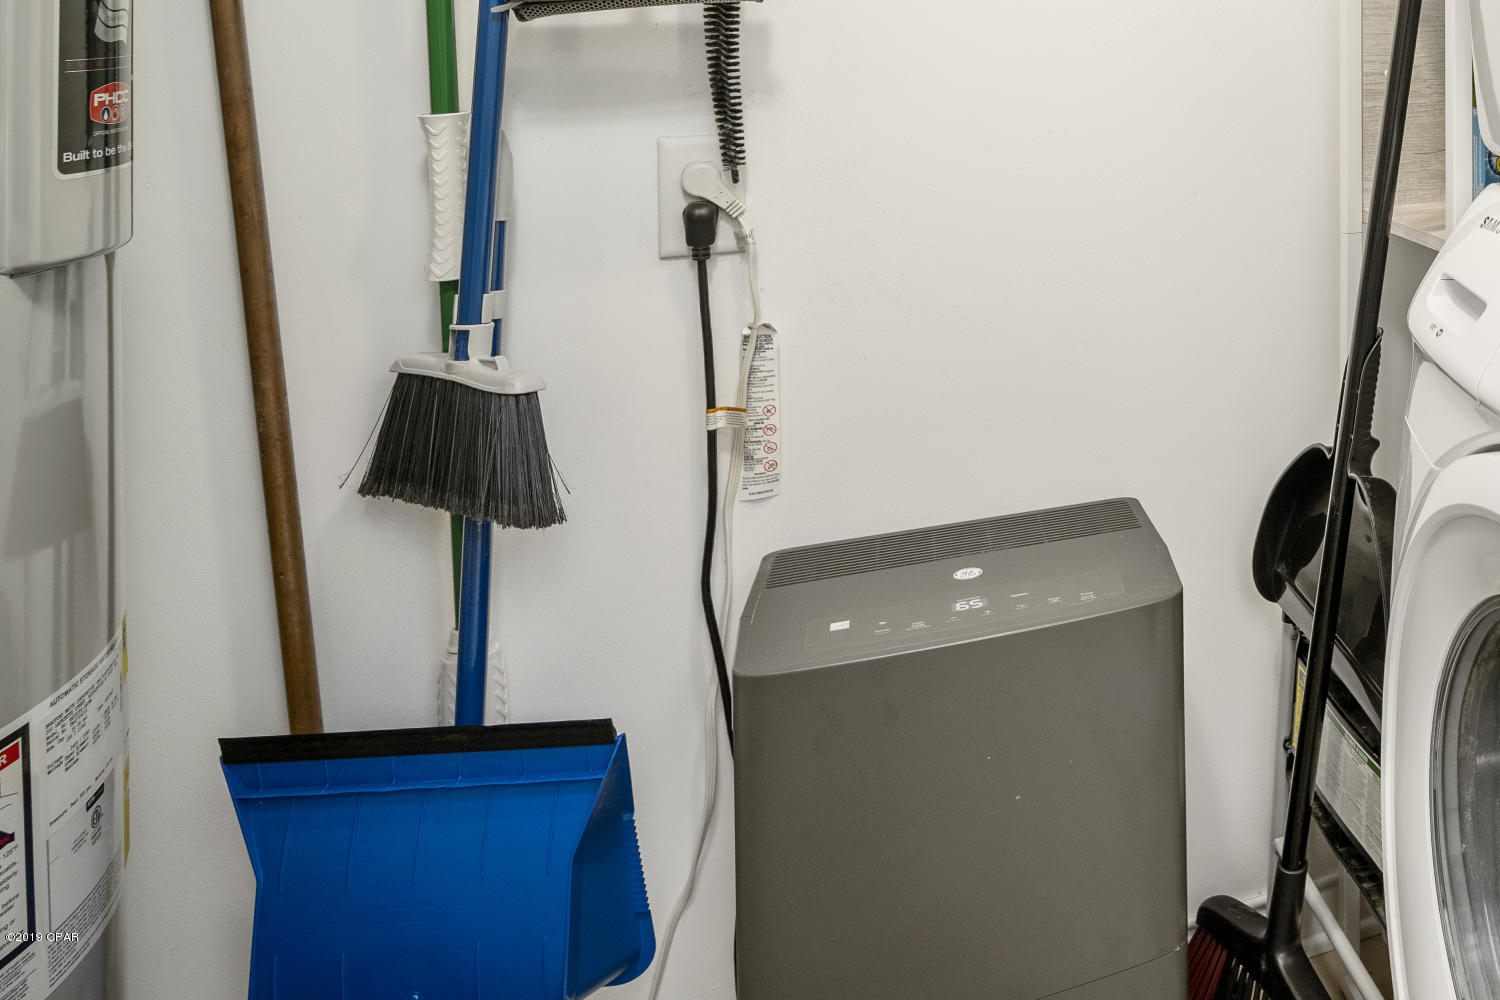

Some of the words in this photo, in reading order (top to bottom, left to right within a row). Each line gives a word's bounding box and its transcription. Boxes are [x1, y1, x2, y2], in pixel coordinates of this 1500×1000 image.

[62, 149, 91, 163] Built
[91, 148, 104, 159] to
[104, 146, 117, 157] be
